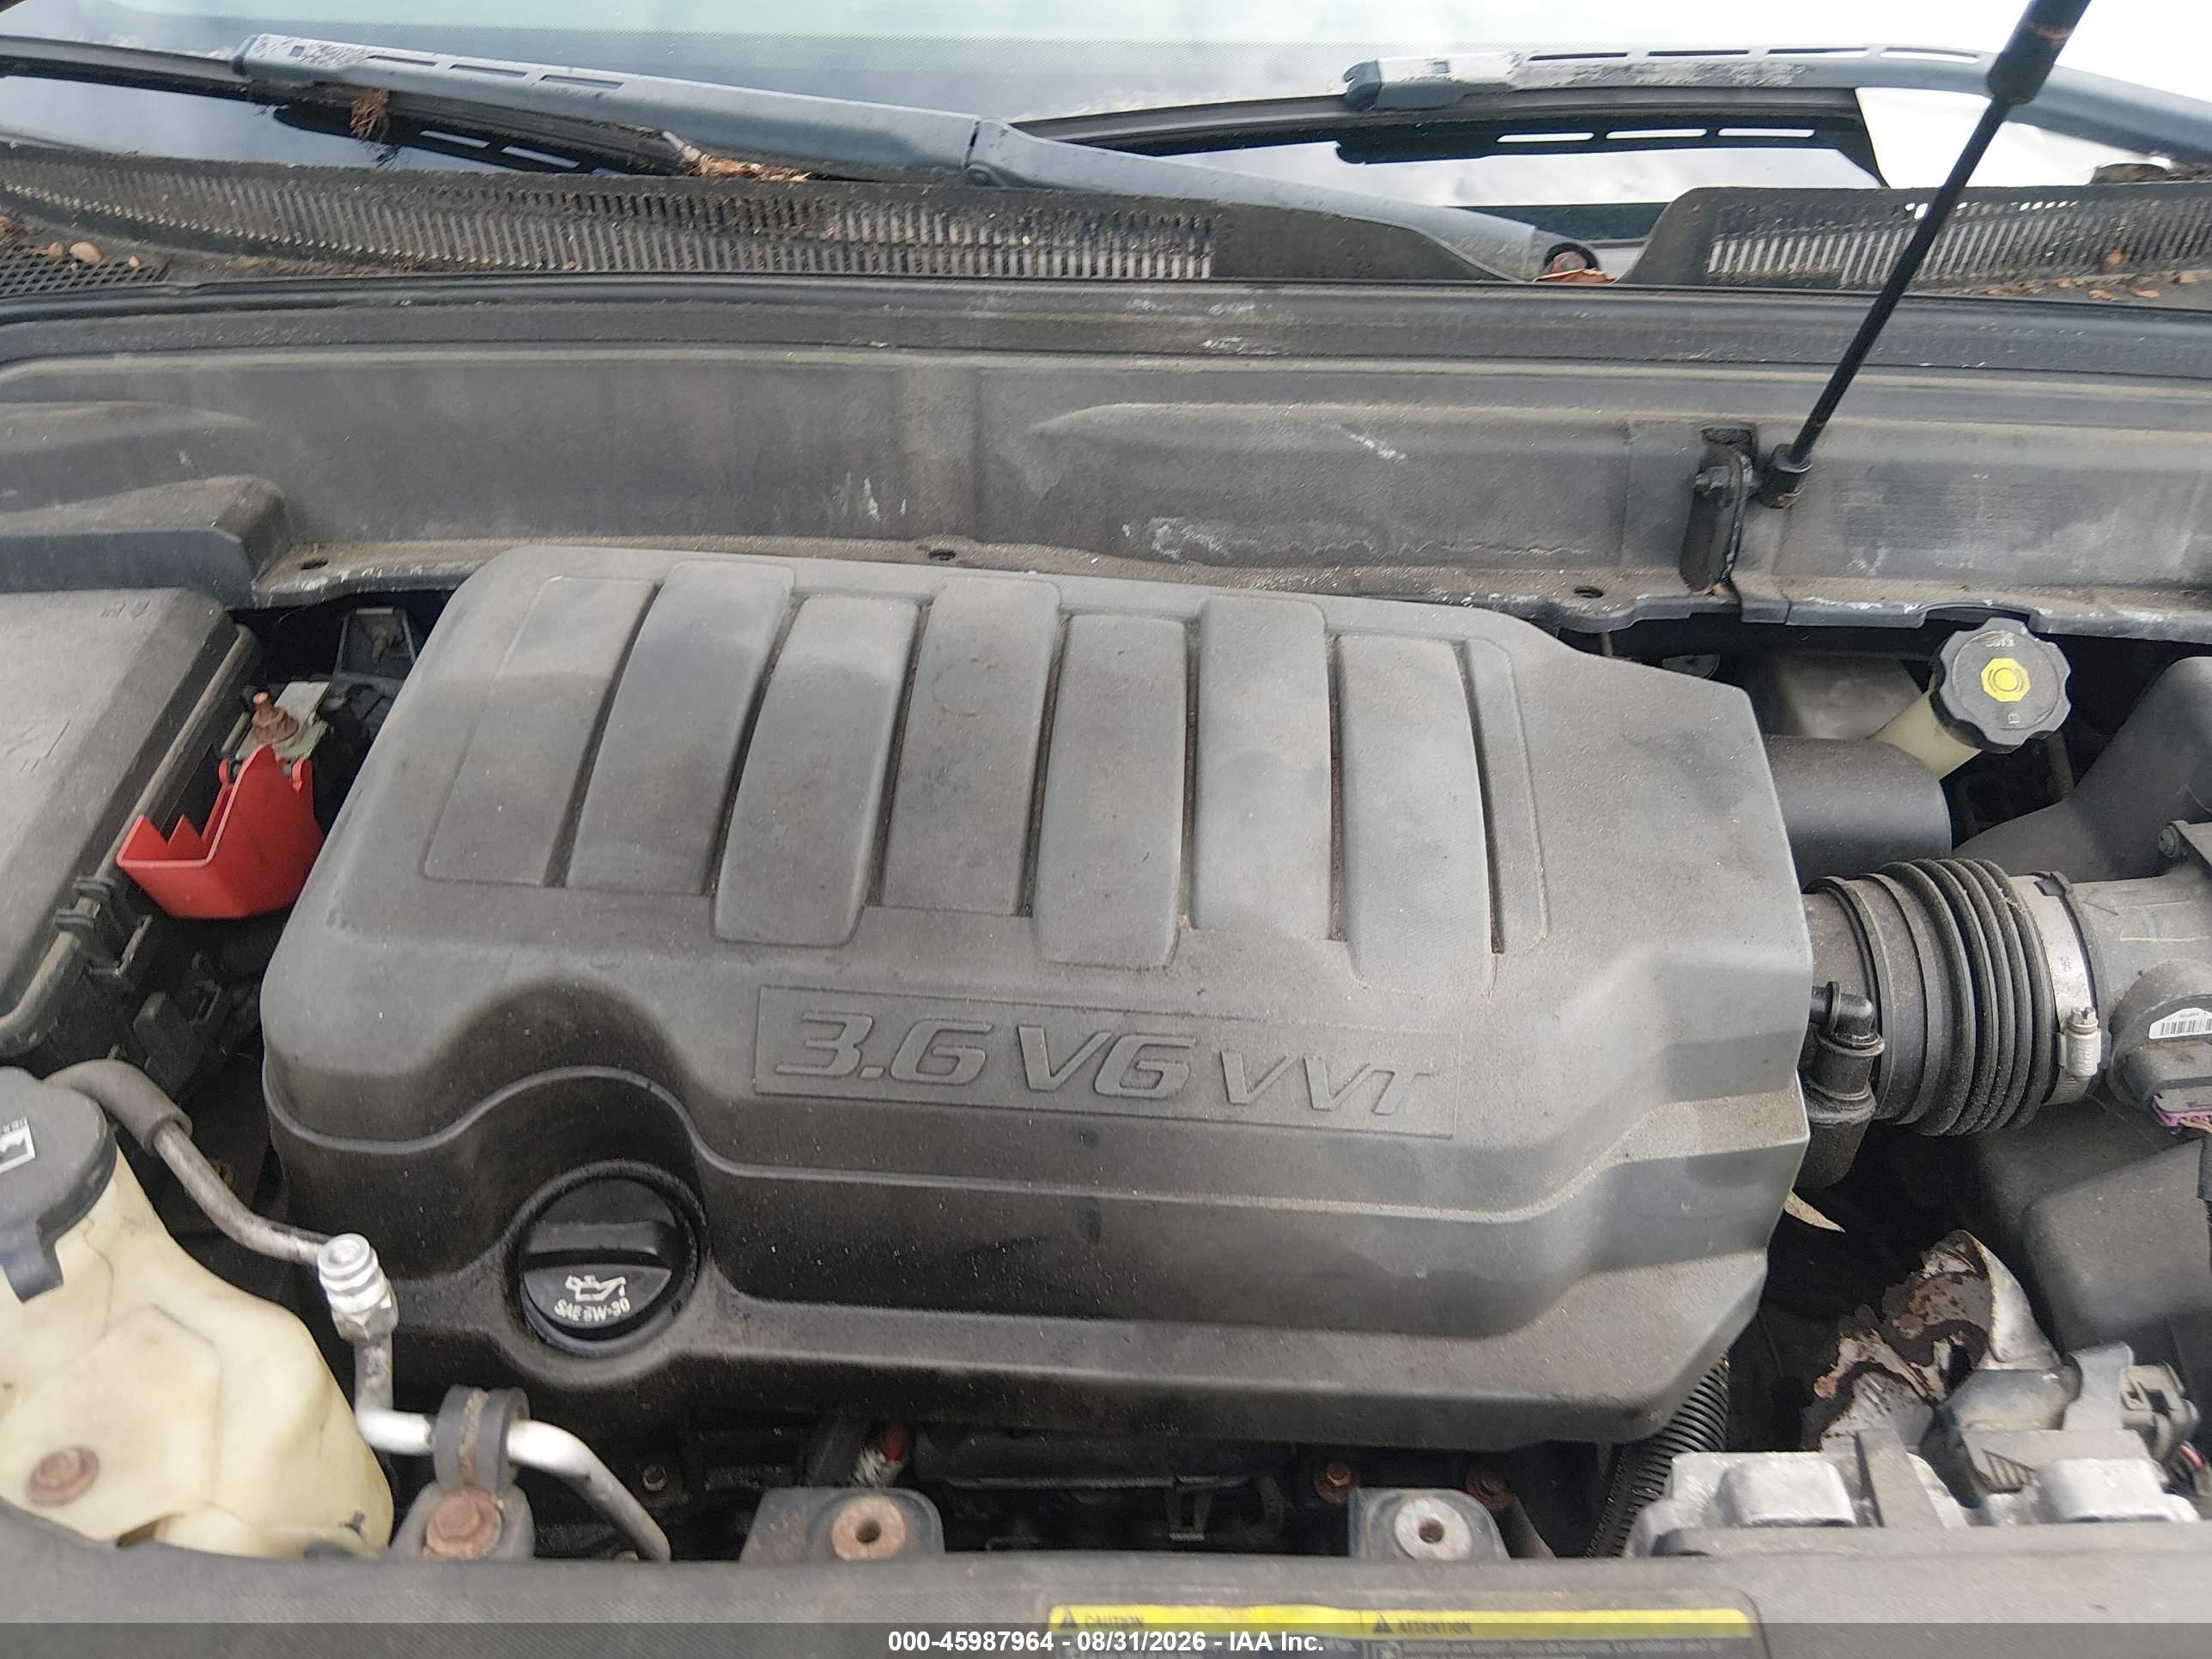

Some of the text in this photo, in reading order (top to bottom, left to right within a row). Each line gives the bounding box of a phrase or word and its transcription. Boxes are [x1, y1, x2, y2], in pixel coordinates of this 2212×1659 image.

[775, 1009, 1443, 1115] 3.6 V6 VVT
[554, 1298, 582, 1322] SAE
